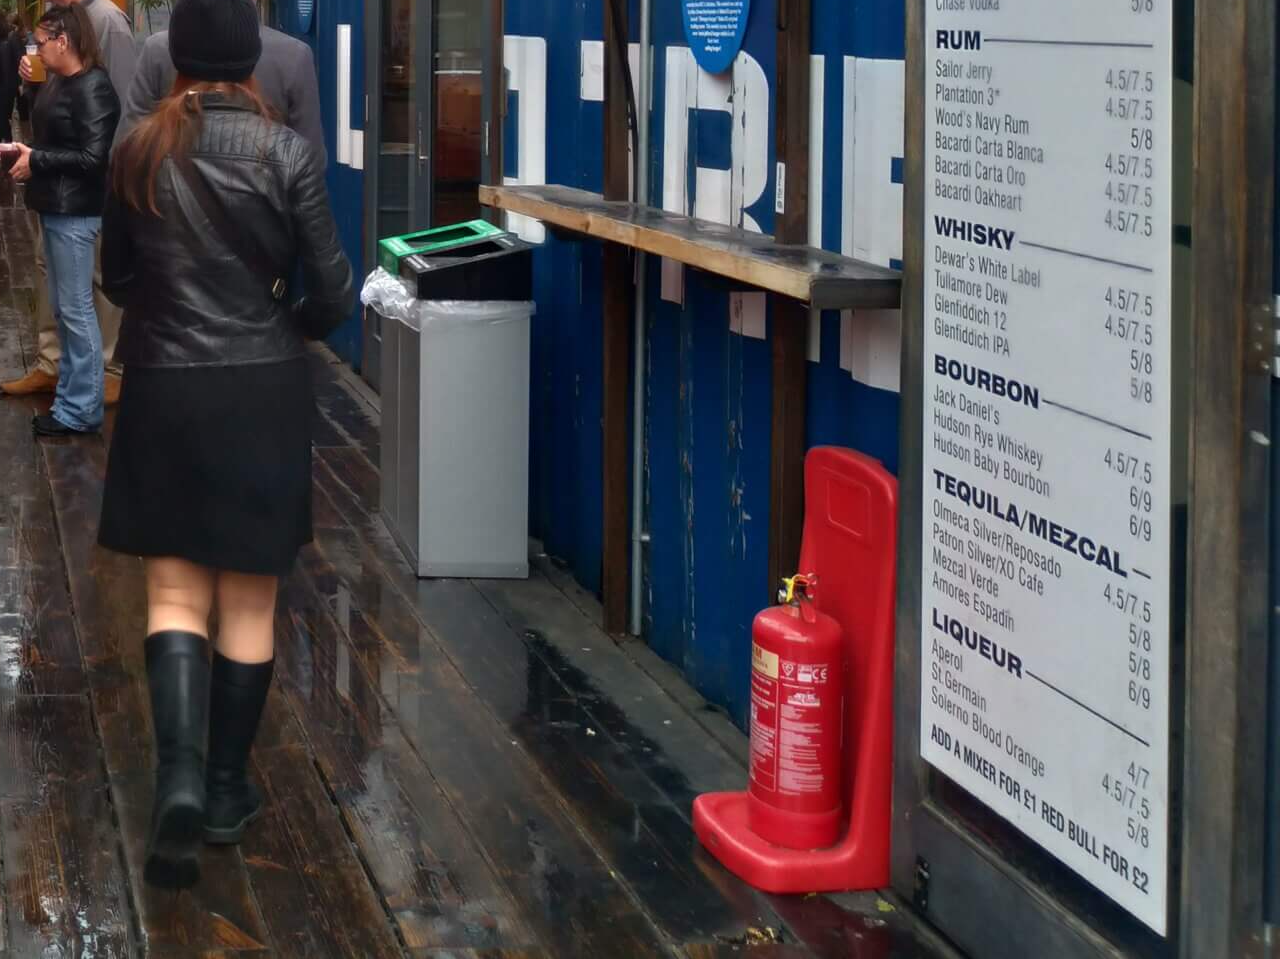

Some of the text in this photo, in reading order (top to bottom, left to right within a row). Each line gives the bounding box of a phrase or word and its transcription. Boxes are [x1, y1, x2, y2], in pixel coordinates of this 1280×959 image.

[935, 59, 1153, 91] Sailor Jerry 4.5/7.5
[936, 30, 981, 51] RUM
[935, 108, 1152, 150] Wood's Navy Rum 5/8
[936, 84, 984, 106] Plantation
[1105, 98, 1153, 120] 4.5/7.5
[935, 131, 1152, 178] Bacardi Carta Blanca 4.5/7.5
[935, 155, 1152, 207] Bacardi Carta Oro 4.5/7.5
[935, 179, 1152, 237] Bacardi Oakheart 4.5/7.5
[935, 216, 1015, 251] WHISKY
[935, 245, 1152, 316] Dewar's White Label 4.5/7.5
[935, 269, 1152, 346] Tullamore Dew 4.5/7.5
[935, 294, 1152, 375] Glenfiddich 12 5/8
[935, 318, 1152, 403] Glenfiddich IPA 5/8
[935, 354, 1039, 409] BOURBON
[934, 384, 1151, 484] Jack Daniel's 4.5/7.5
[934, 409, 1151, 512] Hudson Rye Whiskey 6/9
[933, 469, 1128, 577] TEQUILA/MEZCAL
[934, 433, 1151, 541] Hudson Baby Bourbon 6/9
[933, 523, 963, 554] Patron
[968, 540, 1014, 580] Silver/XO
[1129, 623, 1151, 651] 5/8
[934, 499, 1151, 623] Olmeca Silver/Reposado 4.5/7.5
[932, 608, 1022, 678] LIQUEUR
[933, 546, 1150, 680] Mezcal Verde 5/8
[933, 571, 970, 606] Amores
[1128, 683, 1150, 709] 6/9
[932, 638, 1150, 789] Aperol 4/7
[932, 685, 1149, 849] Solerno Blood Orange 5/8
[1102, 774, 1150, 819] 4.5/7.5
[931, 723, 1149, 895] ADD A MIXER FOR £1 RED BULL FOR £2
